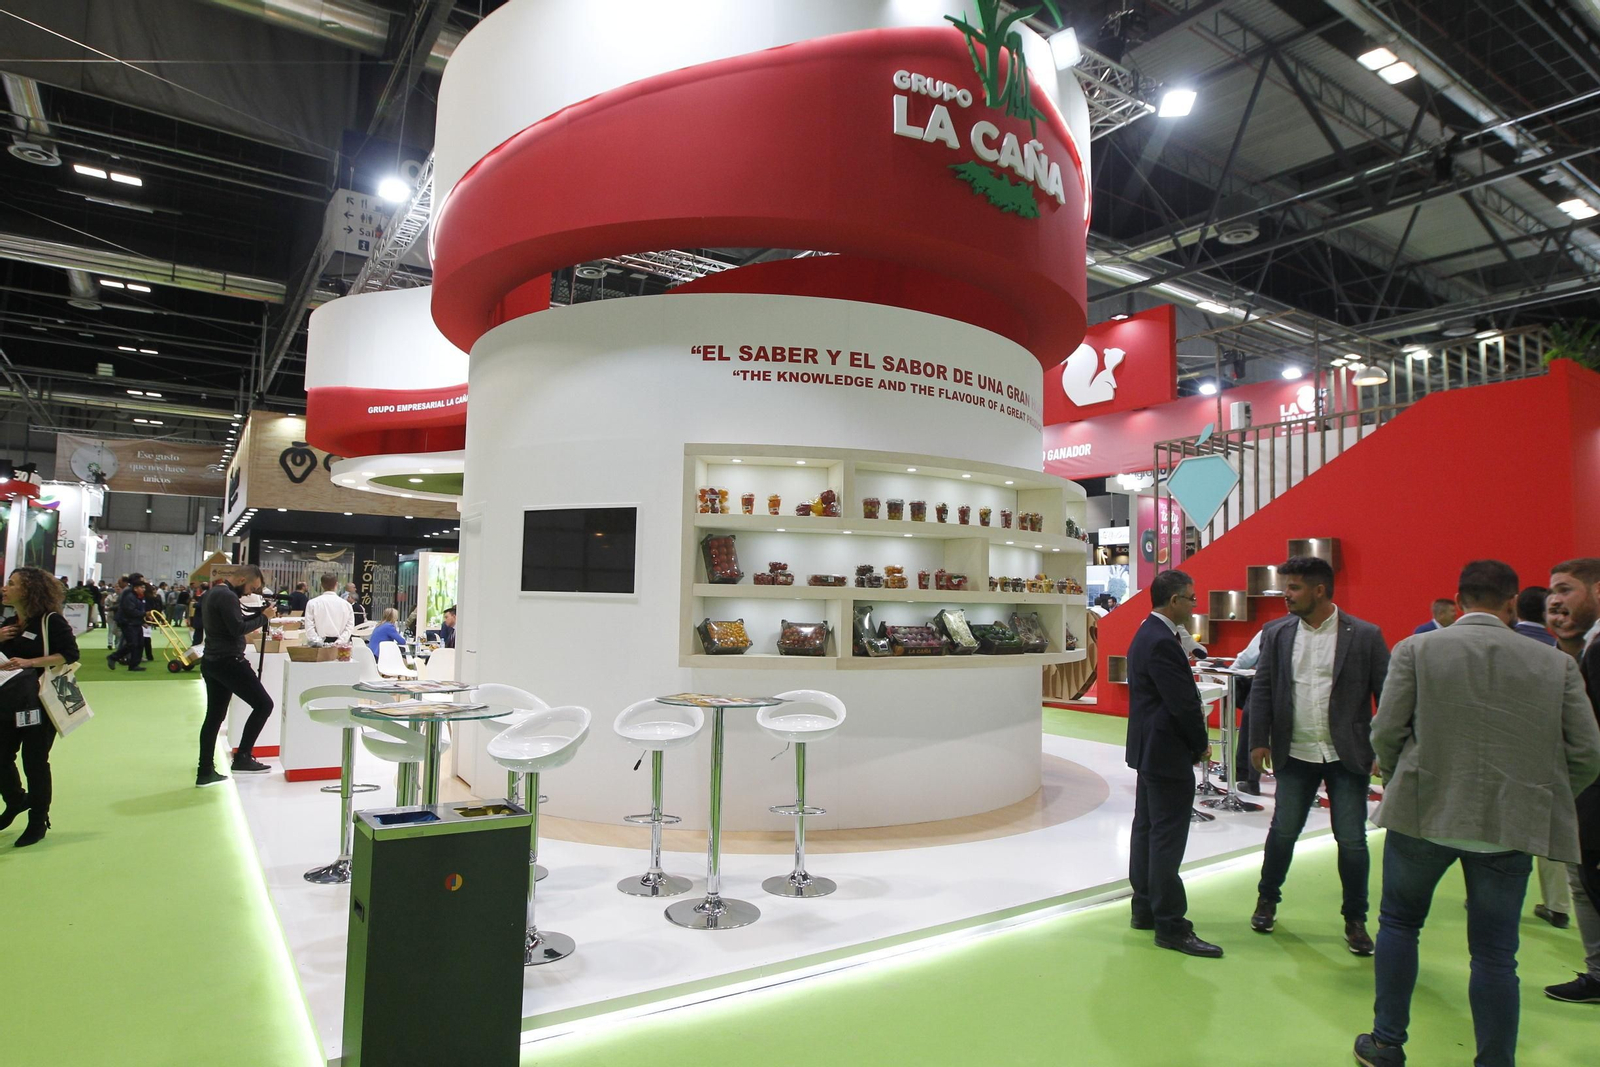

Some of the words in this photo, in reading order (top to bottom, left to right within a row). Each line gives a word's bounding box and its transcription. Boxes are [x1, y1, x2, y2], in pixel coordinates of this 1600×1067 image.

[893, 69, 973, 108] GRUPO
[893, 94, 960, 149] LA
[970, 120, 1066, 204] CAÑA
[359, 228, 377, 238] Sal
[738, 345, 819, 365] SABER
[826, 349, 842, 366] Y
[849, 351, 876, 370] EL
[882, 355, 948, 381] SABOR
[953, 367, 974, 386] DE
[977, 374, 1004, 396] UNA
[1006, 384, 1030, 408] GRAN
[777, 371, 874, 388] KNOWLEDGE
[878, 379, 907, 392] AND
[910, 383, 935, 397] THE
[938, 388, 985, 407] FLAVOUR
[988, 399, 998, 411] OF
[999, 403, 1005, 414] A
[1006, 406, 1026, 422] GREAT
[367, 405, 395, 414] GRUPO
[396, 400, 445, 412] EMPRESARIAL
[446, 398, 454, 406] LA
[1280, 402, 1300, 417] LA
[137, 450, 154, 459] Ese
[155, 453, 180, 462] gusto
[1047, 443, 1092, 461] GANADOR
[129, 462, 147, 472] que
[164, 464, 187, 473] hace
[143, 474, 171, 484] únicos
[56, 537, 75, 549] cia
